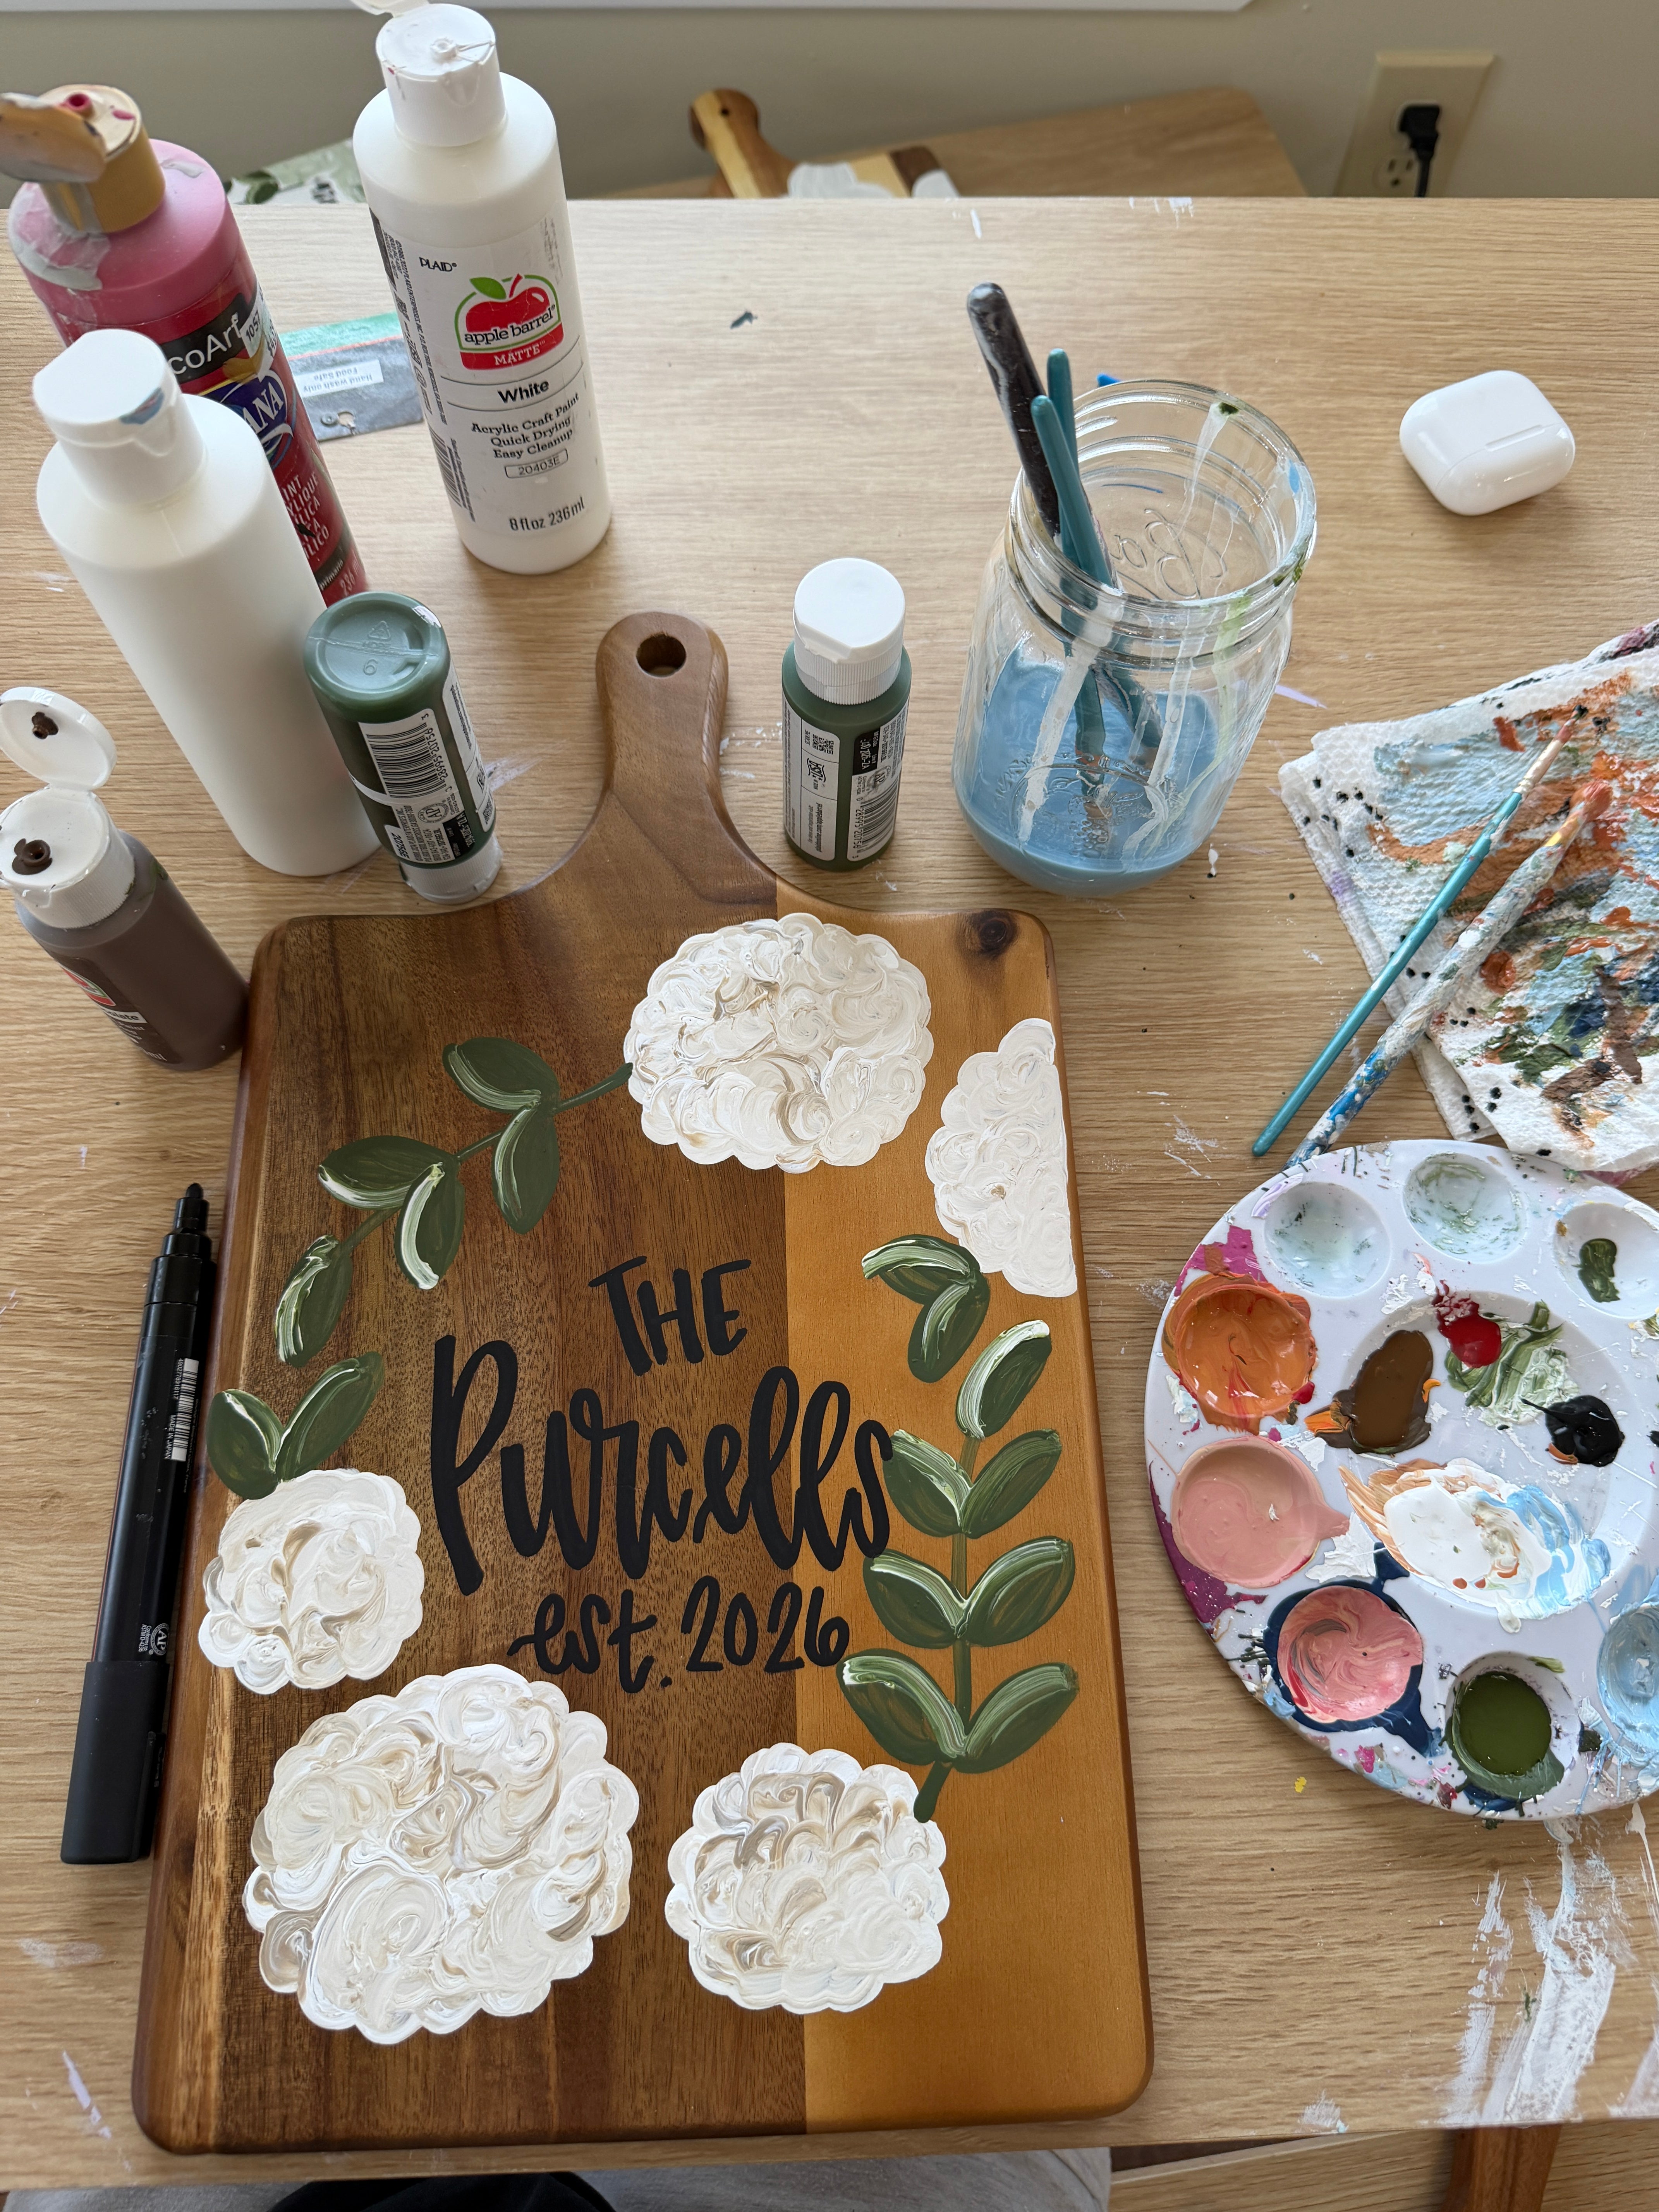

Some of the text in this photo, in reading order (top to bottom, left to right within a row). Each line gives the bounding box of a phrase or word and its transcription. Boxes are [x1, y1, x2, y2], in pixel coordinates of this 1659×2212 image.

[168, 312, 242, 375] coArt
[464, 329, 509, 345] apple
[303, 374, 373, 393] Hand wash only
[314, 367, 358, 381] Food Safe
[497, 381, 549, 403] White
[242, 382, 284, 435] ANA
[471, 392, 579, 436] Acrylic Craft Paint
[491, 416, 571, 448] Quick Drying
[493, 429, 573, 459] Easy Cleanup
[518, 455, 561, 475] 20403E
[282, 474, 302, 501] INT
[286, 471, 319, 516] YLIQUE
[509, 518, 519, 531] 8
[531, 519, 546, 530] oz
[303, 524, 329, 559] ILICO
[809, 760, 823, 778] USA
[426, 807, 442, 818] AP
[855, 808, 864, 828] 28995
[391, 832, 410, 859] 20756E
[853, 830, 862, 849] 20756
[107, 1010, 140, 1021] olate
[588, 1255, 752, 1377] THE
[173, 1358, 184, 1400] 4902778916117
[168, 1414, 176, 1431] MADE
[164, 1439, 173, 1460] JAPAN
[430, 1334, 894, 1597] Purcells
[157, 1630, 167, 1650] AP
[506, 1575, 852, 1694] est. 2026
